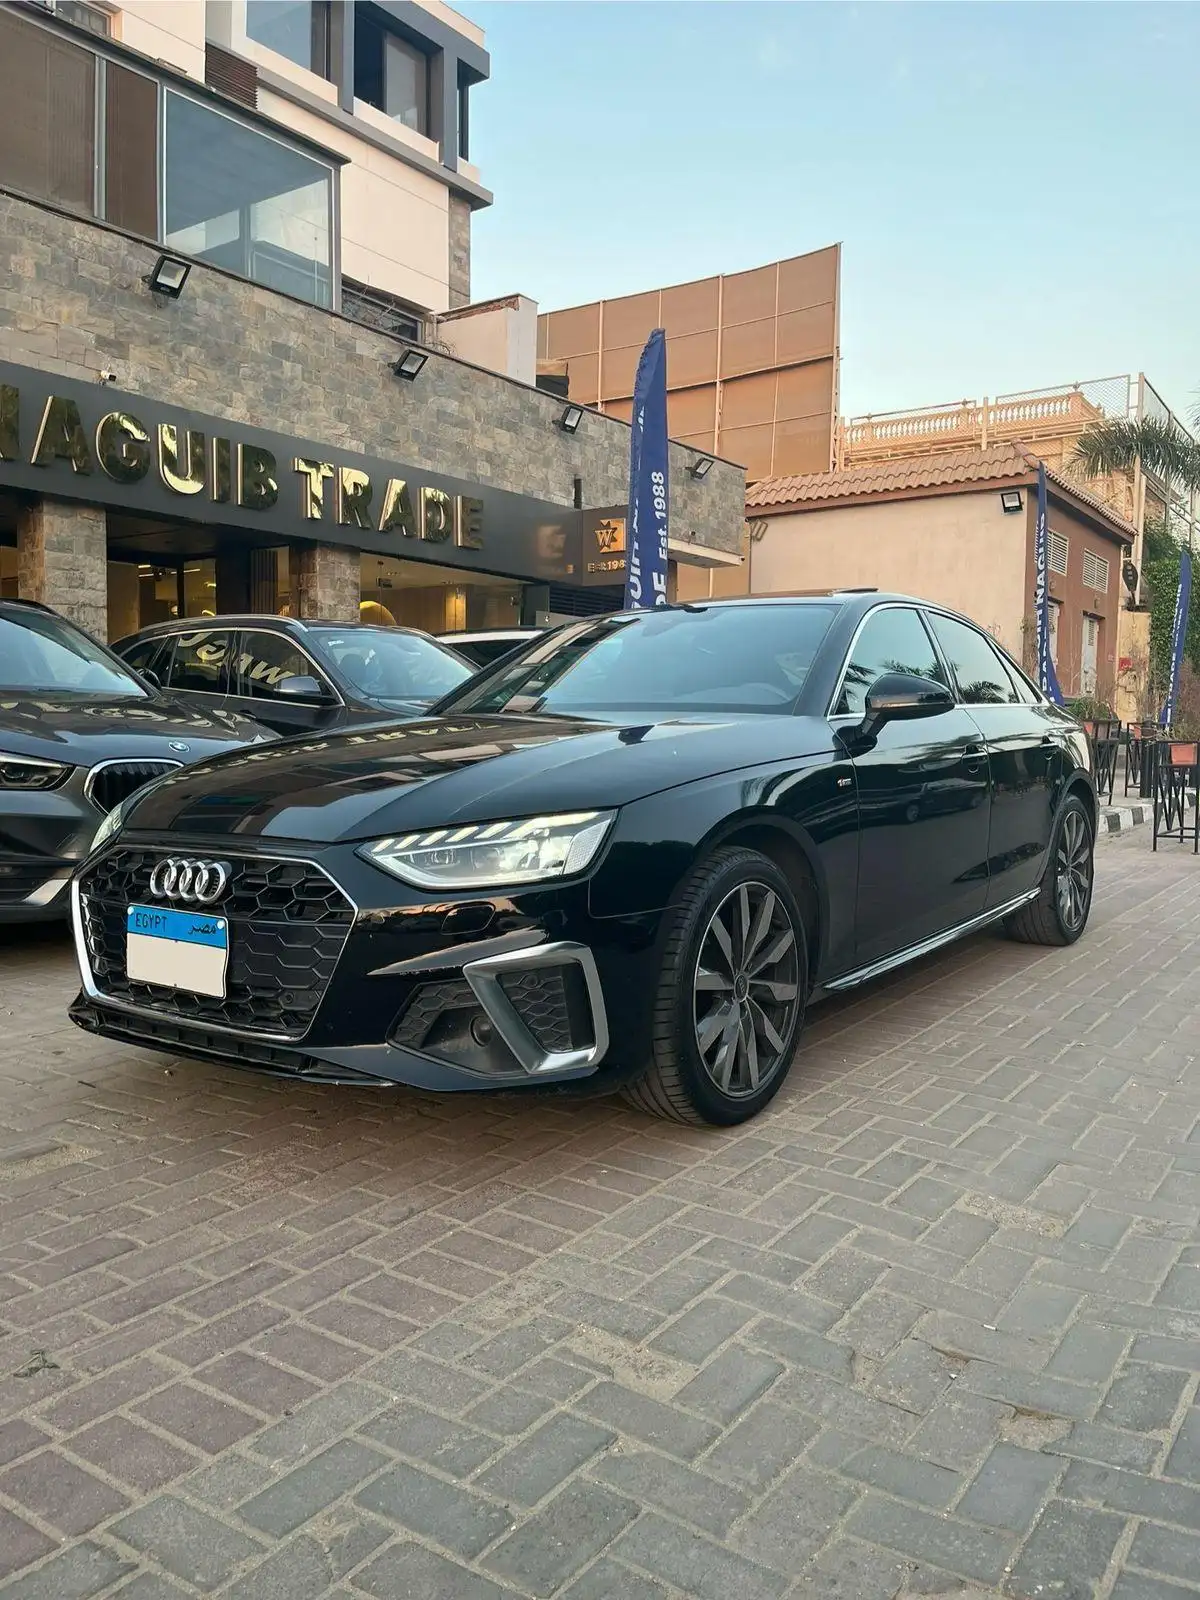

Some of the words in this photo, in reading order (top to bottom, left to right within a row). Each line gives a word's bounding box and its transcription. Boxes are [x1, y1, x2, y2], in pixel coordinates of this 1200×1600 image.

[292, 456, 485, 550] TRADE
[651, 471, 667, 520] 1988
[658, 524, 668, 561] Est.
[135, 912, 168, 933] EGYPT
